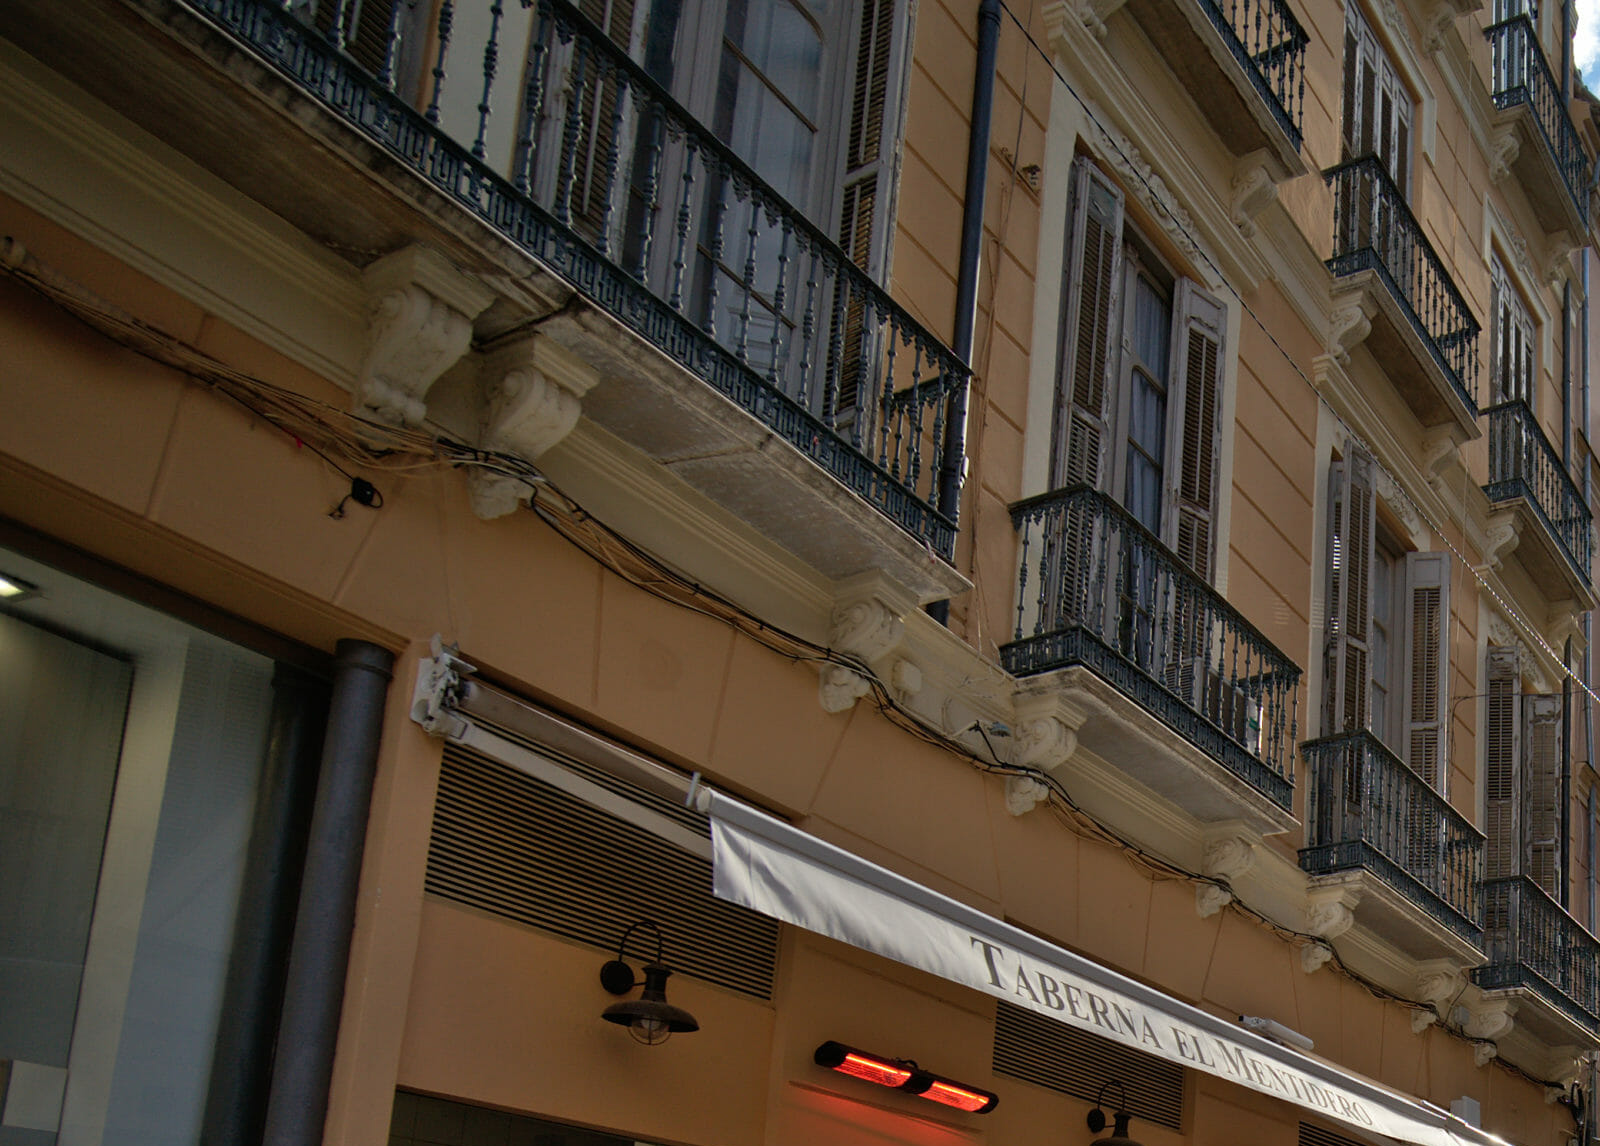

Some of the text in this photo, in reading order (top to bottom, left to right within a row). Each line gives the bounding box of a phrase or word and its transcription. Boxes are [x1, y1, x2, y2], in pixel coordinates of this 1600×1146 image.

[969, 936, 1374, 1126] TABERNA EL MENTIDERO
